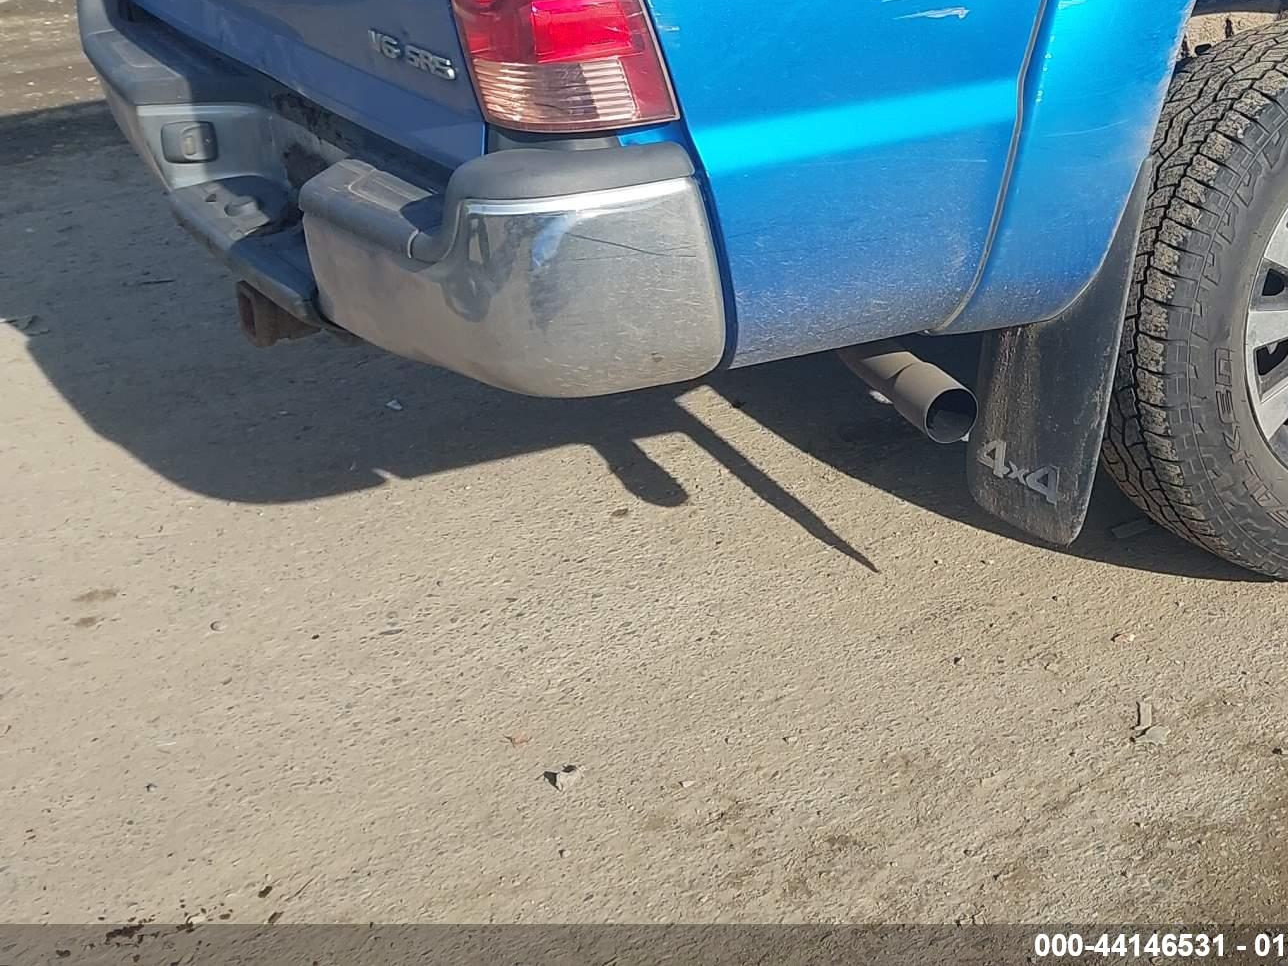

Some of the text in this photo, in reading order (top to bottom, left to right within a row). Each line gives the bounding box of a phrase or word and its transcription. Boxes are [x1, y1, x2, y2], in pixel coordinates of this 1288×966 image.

[367, 29, 456, 80] V6 SR5
[976, 440, 1061, 506] 4x4
